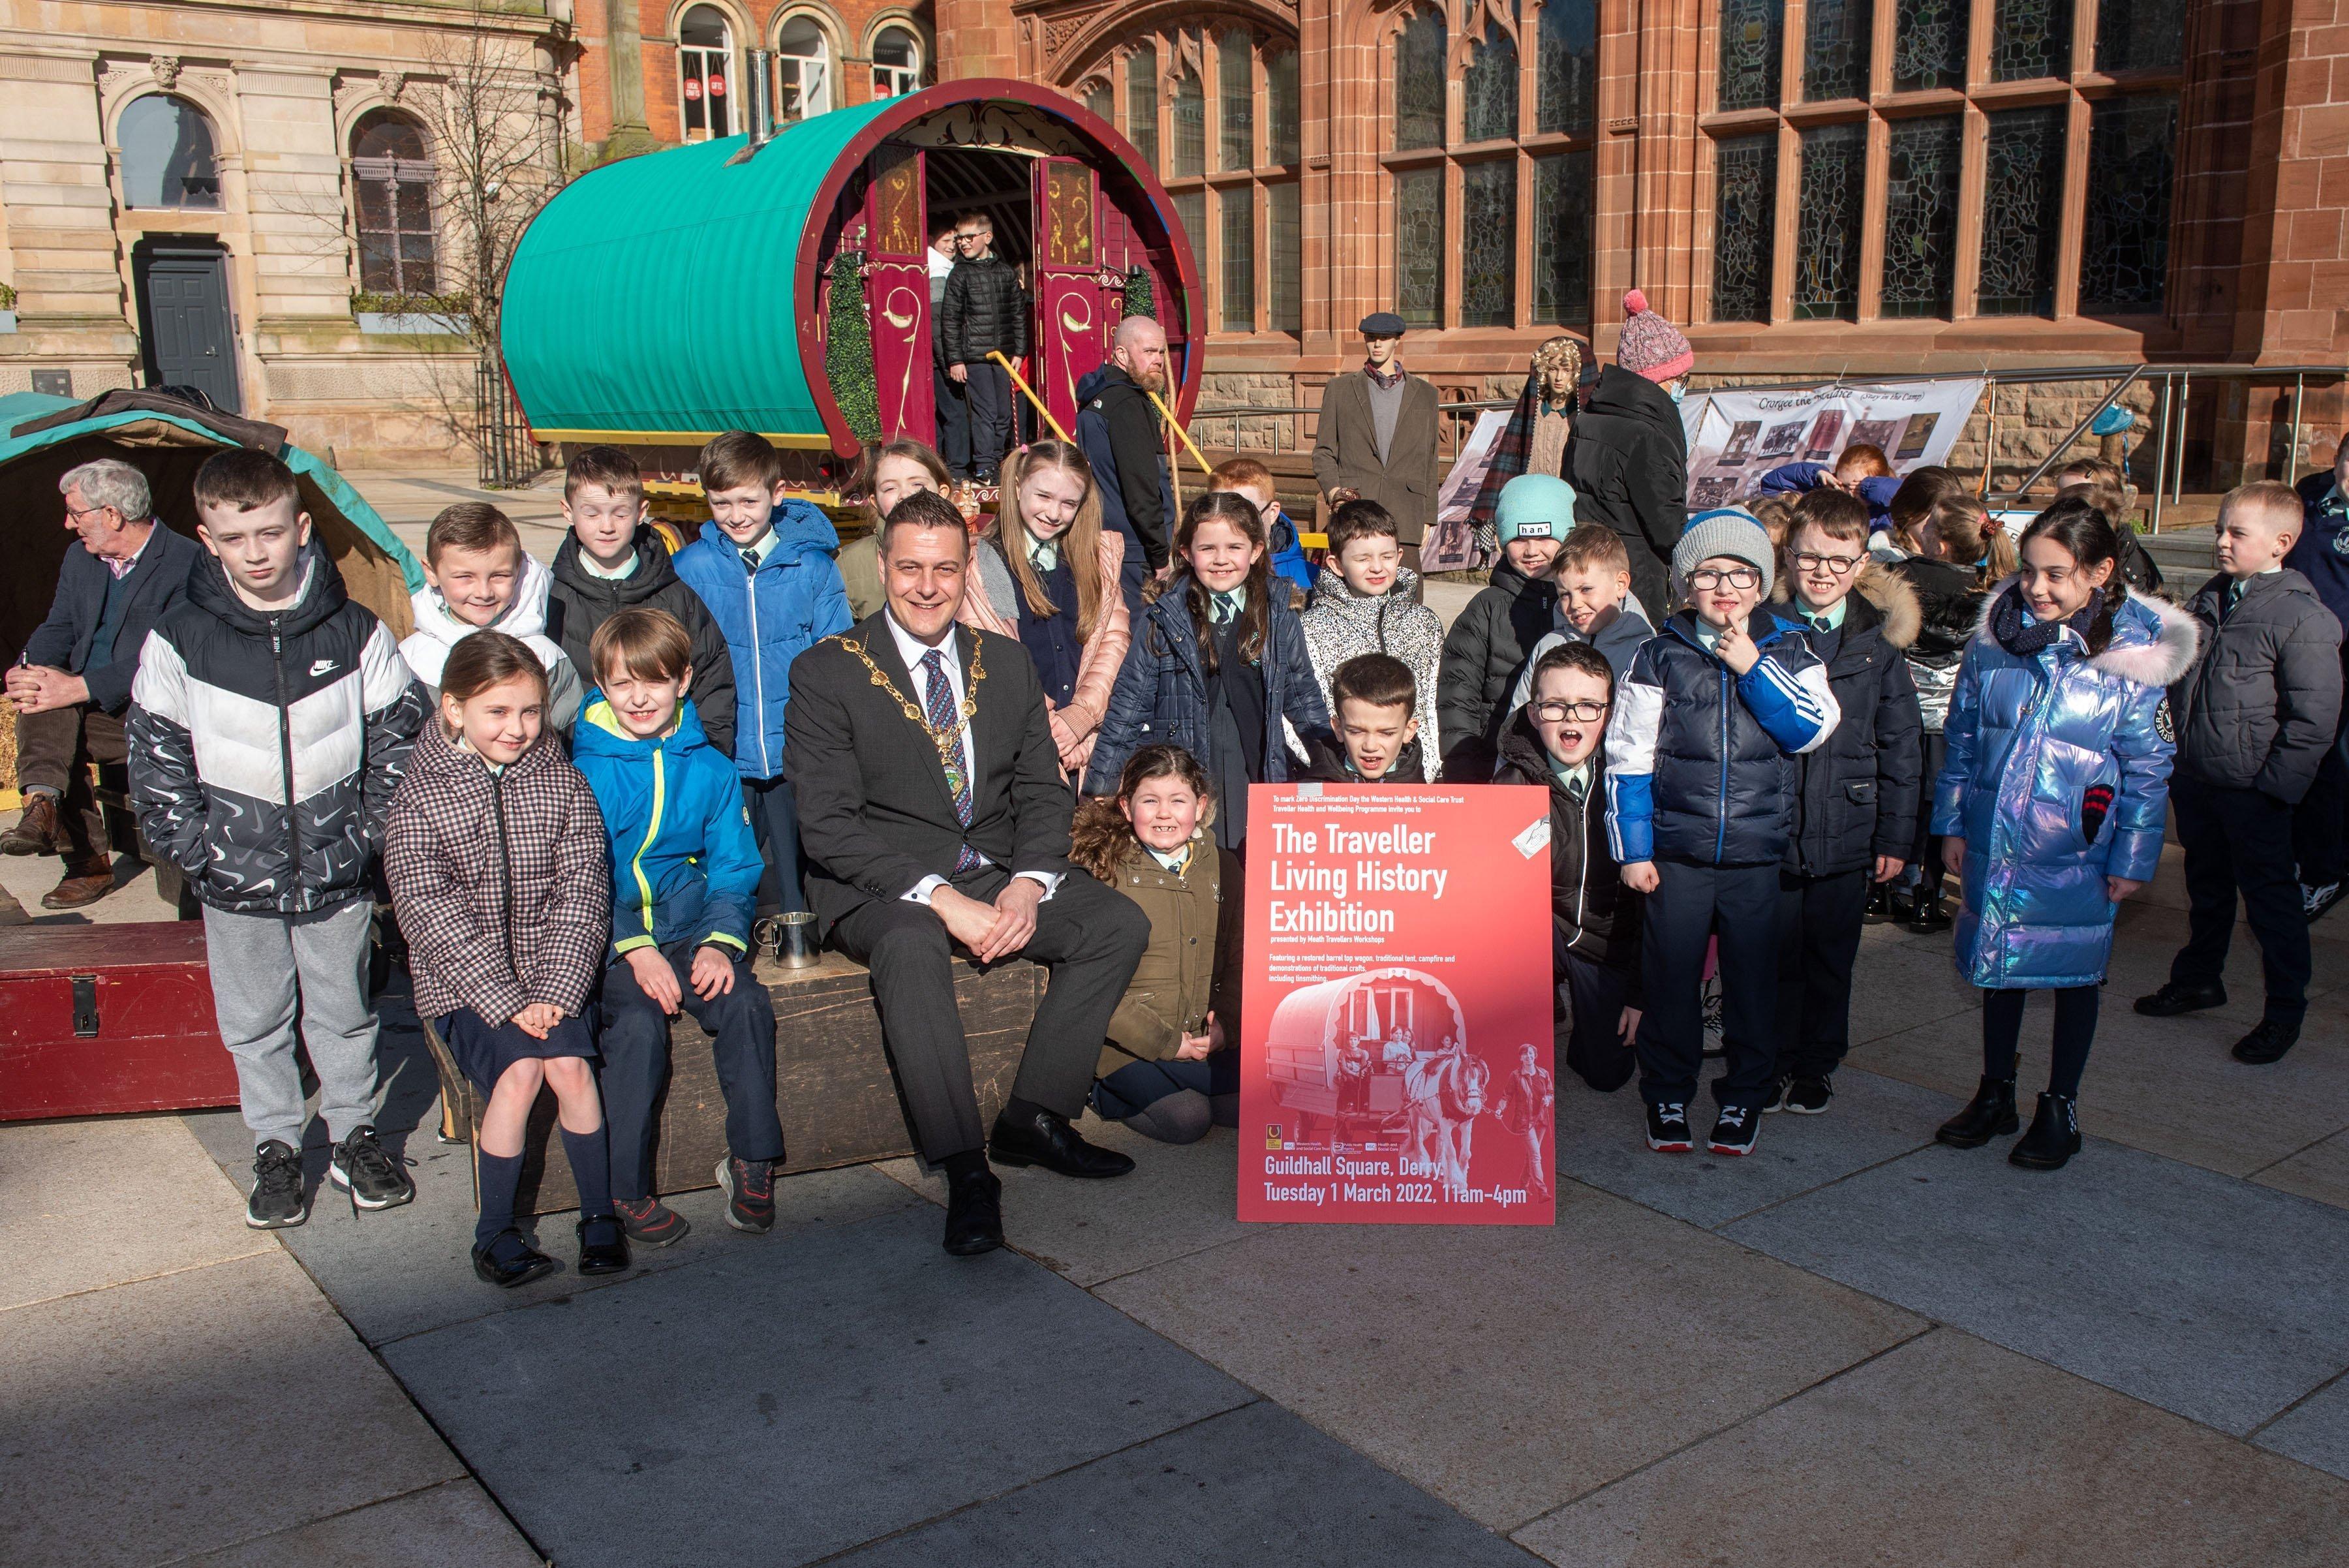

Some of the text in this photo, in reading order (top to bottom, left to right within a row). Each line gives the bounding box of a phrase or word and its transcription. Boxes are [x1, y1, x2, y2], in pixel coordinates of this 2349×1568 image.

[1891, 392, 1902, 401] the
[1901, 391, 1925, 402] Camp)
[314, 660, 333, 670] NIKE
[1349, 795, 1360, 805] Day
[1273, 805, 1297, 813] Traveller
[1297, 805, 1315, 813] Health
[1327, 805, 1355, 814] Wellbeing
[1355, 805, 1387, 814] Programme
[1272, 823, 1436, 855] The Traveller
[1270, 861, 1448, 900] Living History
[1270, 901, 1394, 932] Exhibition
[1270, 935, 1385, 945] presented by Meath Travellers Workshops
[1269, 953, 1296, 964] Featuring
[1301, 954, 1325, 962] restored
[1343, 954, 1353, 964] top
[1375, 954, 1404, 962] traditional
[1418, 955, 1443, 964] campfire
[1268, 964, 1367, 974] demonstrations of traditional crafts,
[1268, 974, 1328, 984] including tinsmithing.
[1265, 1156, 1444, 1181] Guildhall Square, Derry.
[1263, 1182, 1326, 1207] Tuesday
[1330, 1183, 1338, 1202] 1
[1344, 1182, 1391, 1203] March
[1396, 1183, 1437, 1204] 2022,
